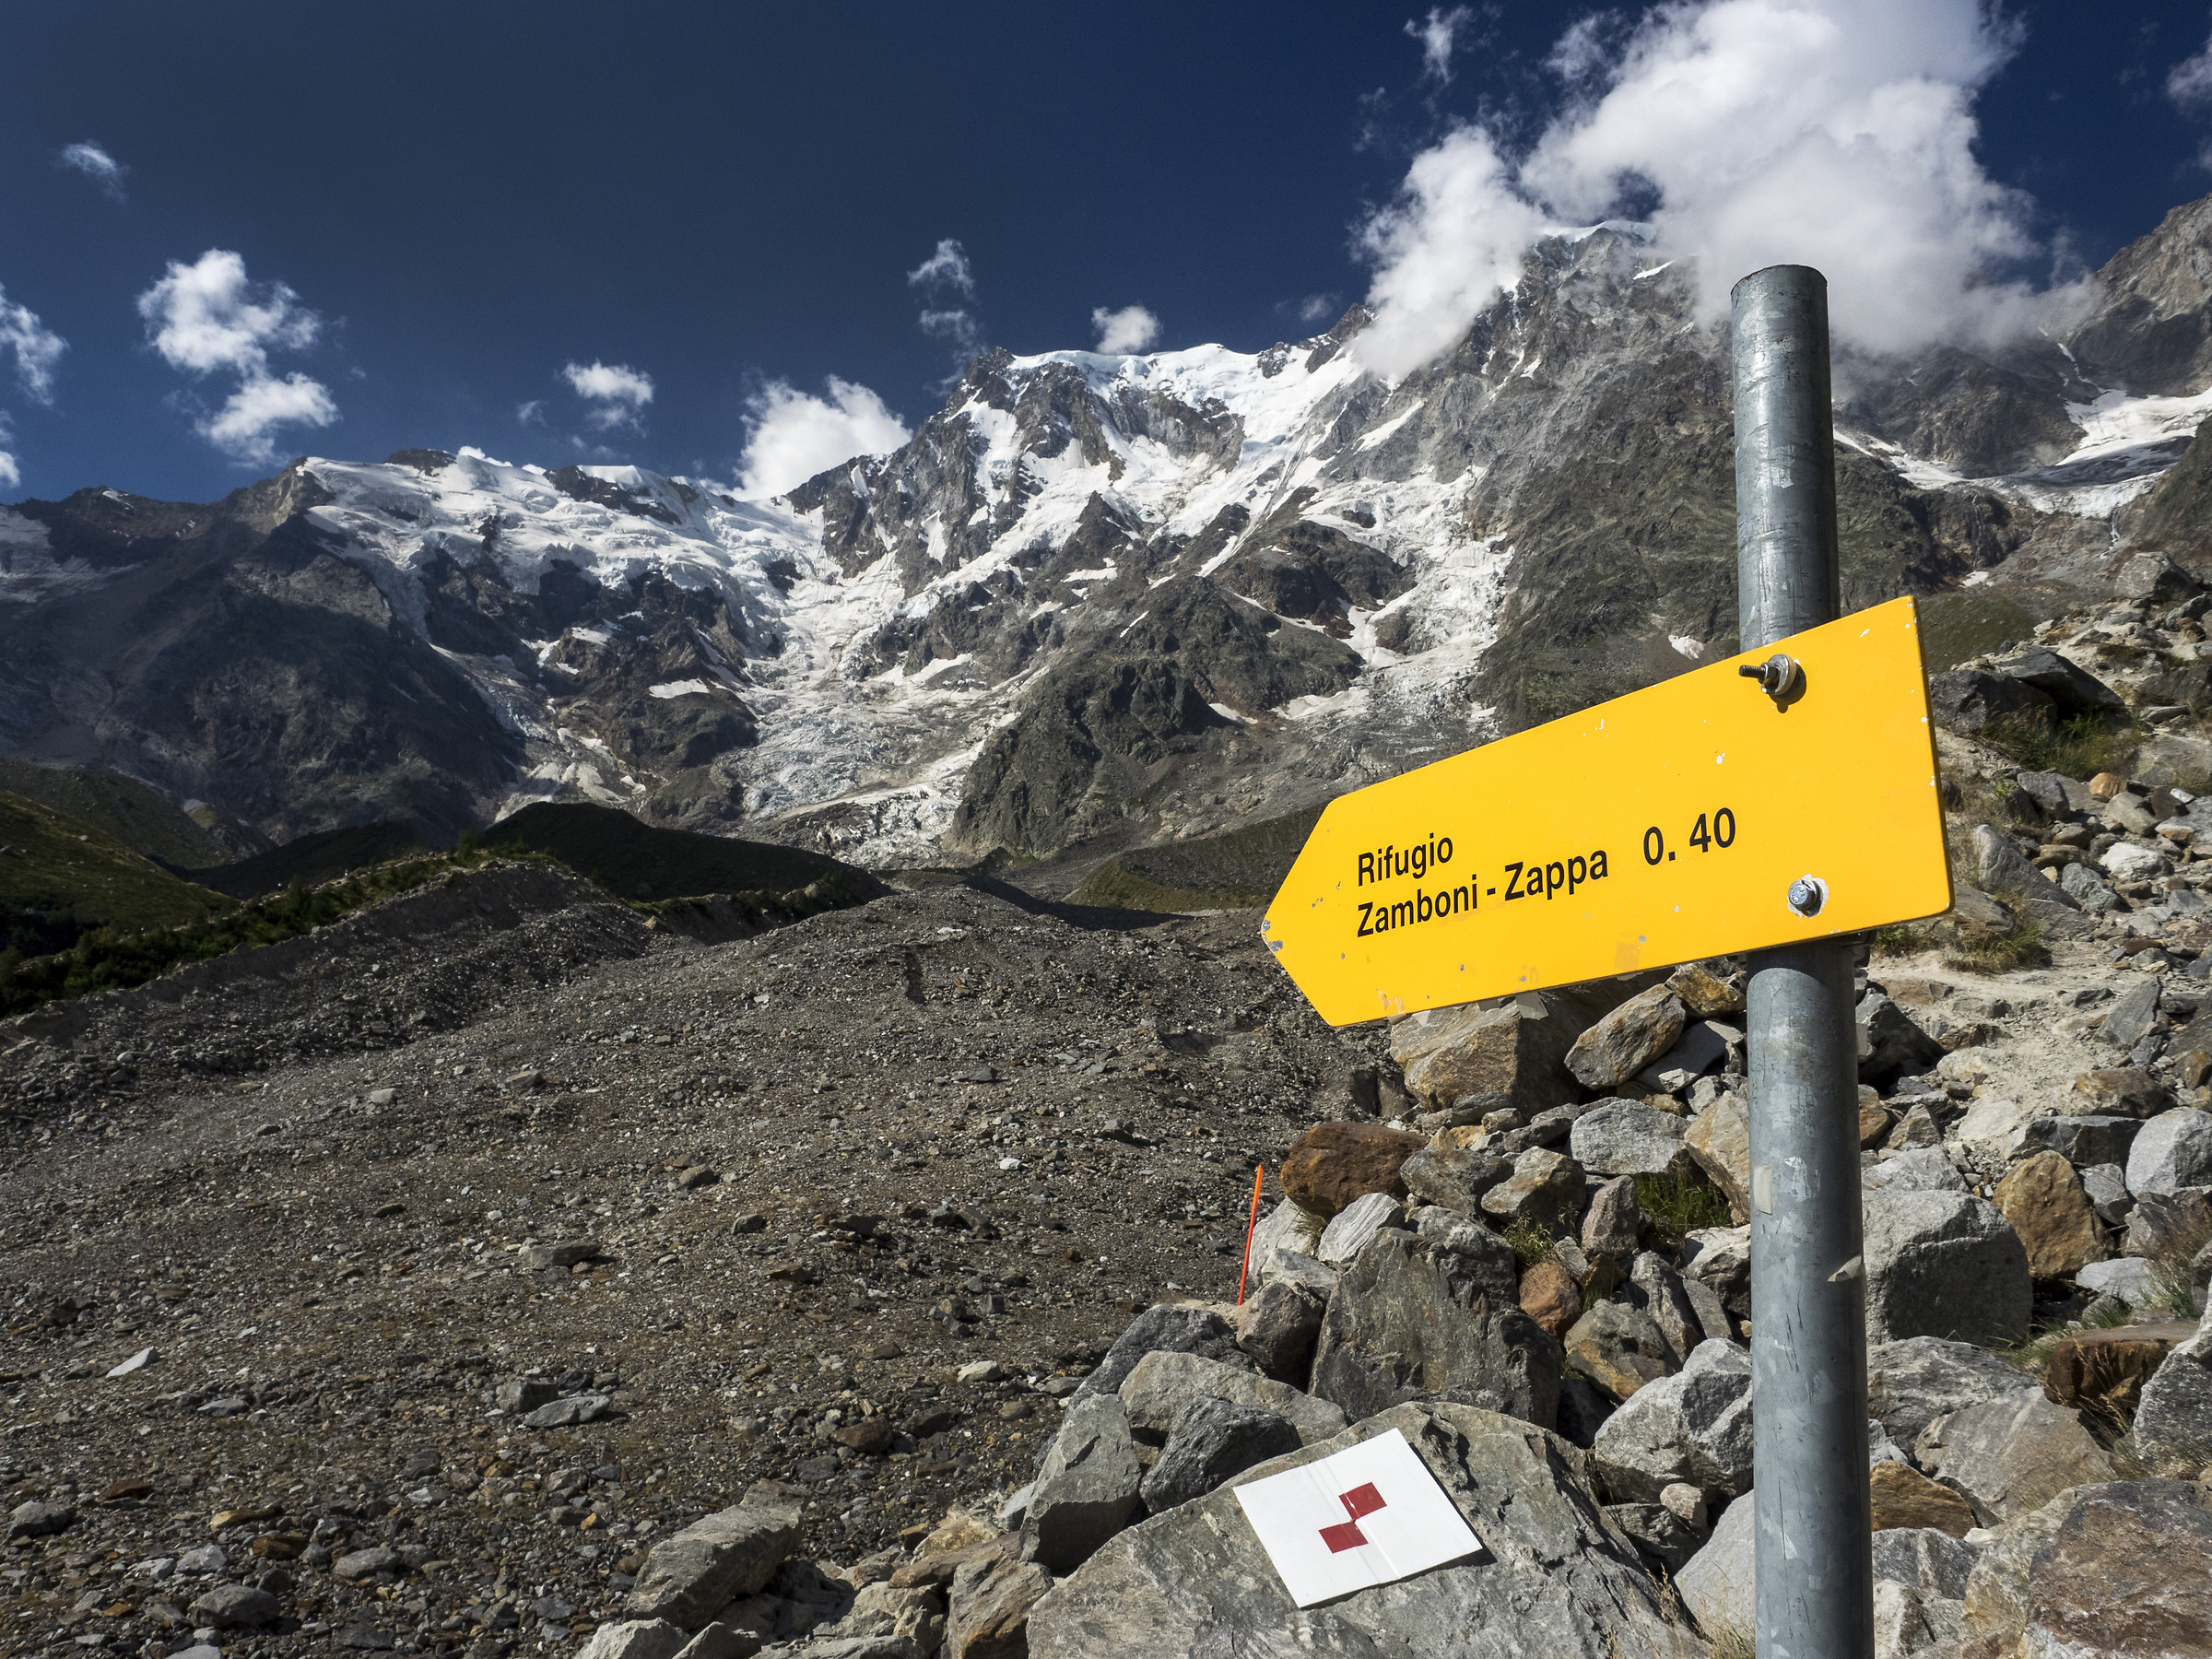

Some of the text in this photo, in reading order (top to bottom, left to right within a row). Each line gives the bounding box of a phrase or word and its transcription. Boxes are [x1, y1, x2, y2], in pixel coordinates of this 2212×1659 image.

[1357, 833, 1453, 887] Rifugio
[1357, 873, 1478, 937] Zamboni
[1503, 850, 1609, 901] Zappa
